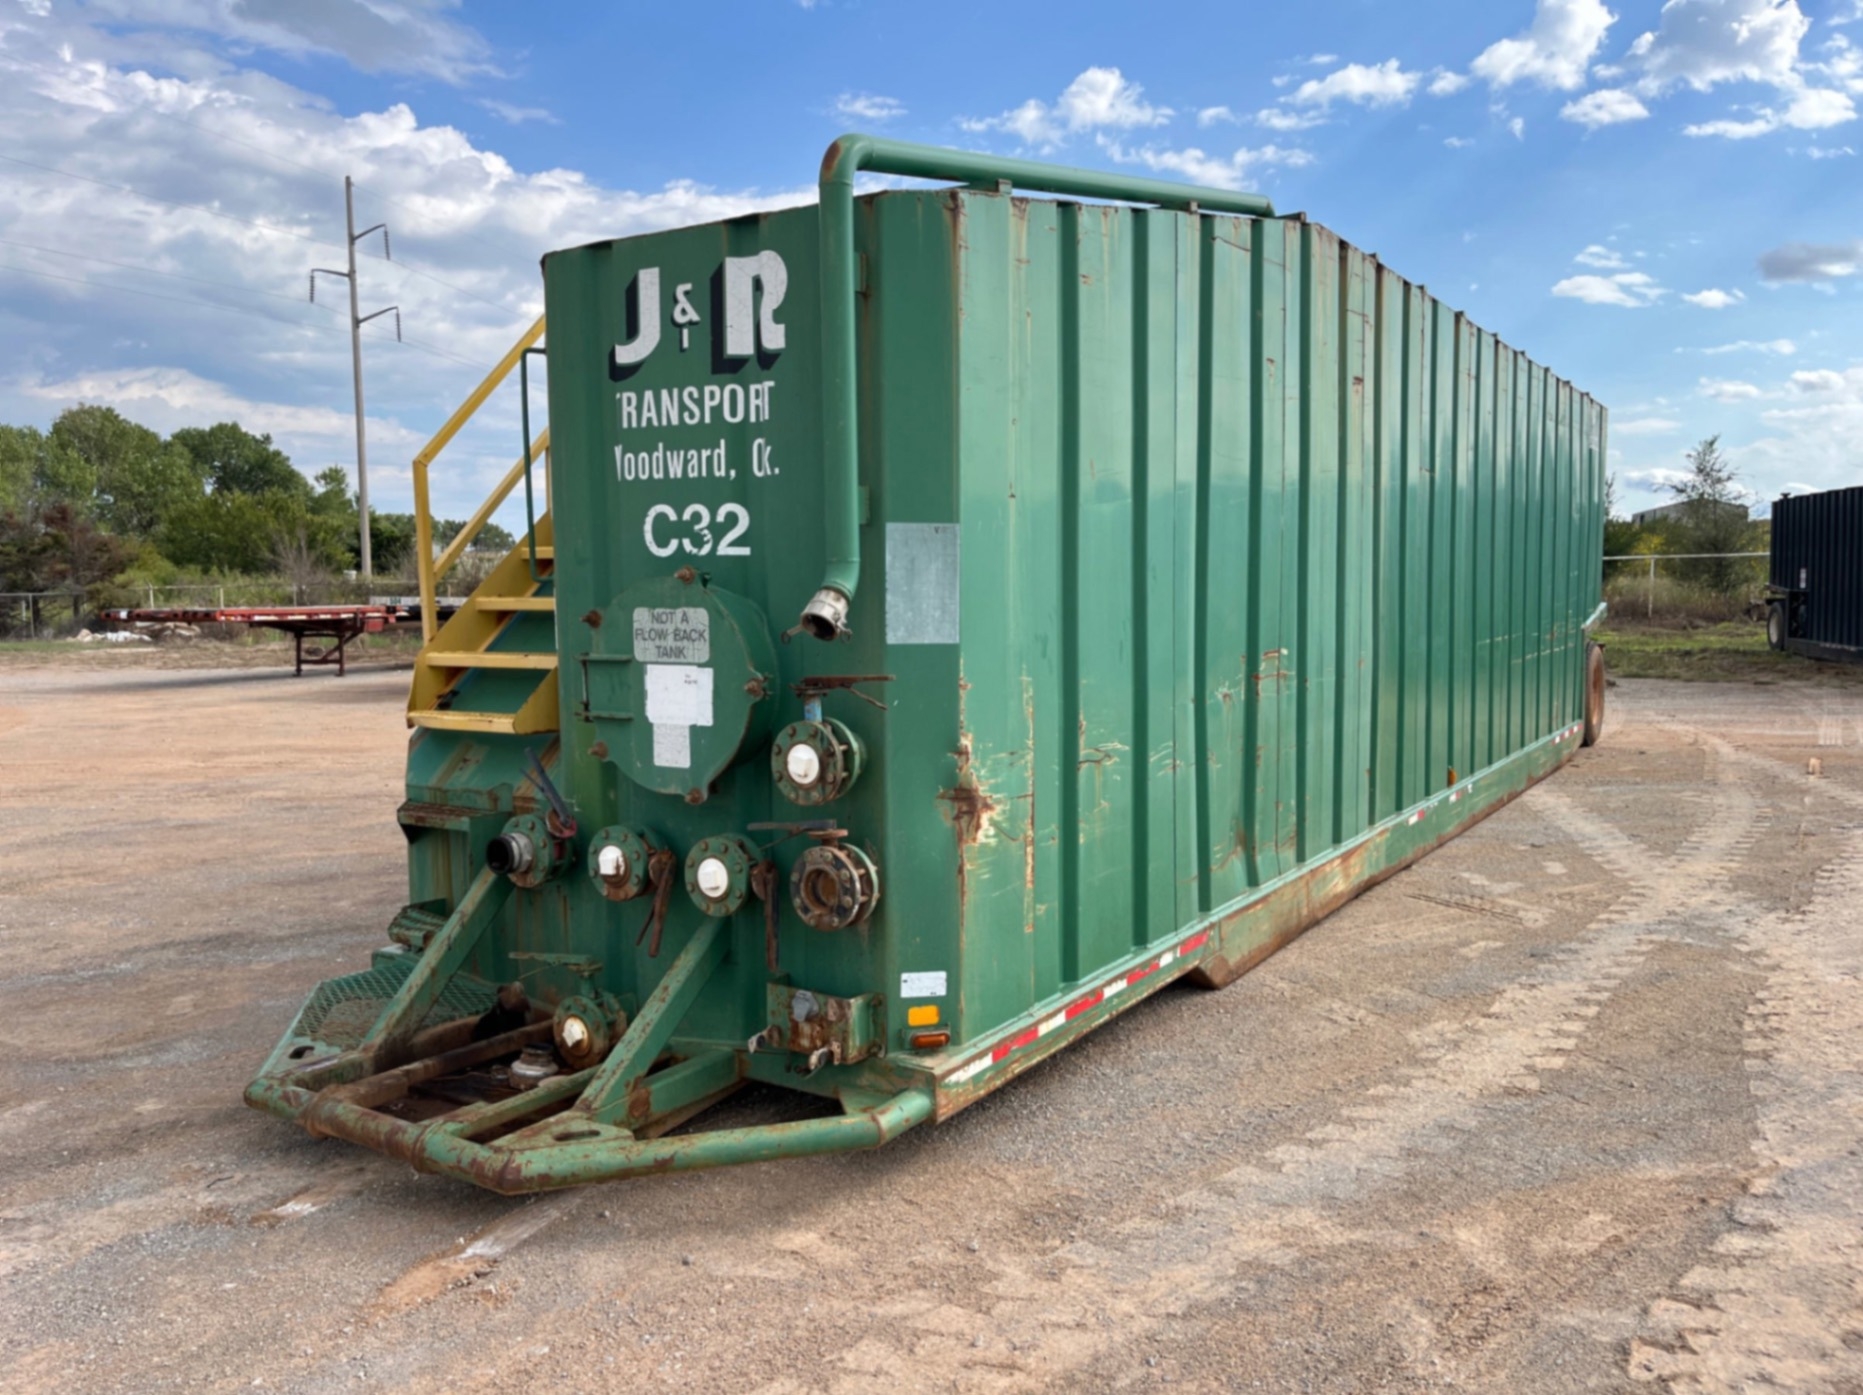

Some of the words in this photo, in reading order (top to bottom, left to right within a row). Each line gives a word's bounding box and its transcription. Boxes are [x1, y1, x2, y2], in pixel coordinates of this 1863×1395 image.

[613, 266, 661, 365] J
[725, 249, 788, 356] R
[616, 380, 775, 429] RANSPORT
[643, 502, 751, 557] C32
[651, 611, 676, 624] NOT
[681, 610, 689, 624] A
[635, 628, 668, 641] FLOW
[673, 628, 706, 642] BACK
[655, 645, 686, 659] TANK
